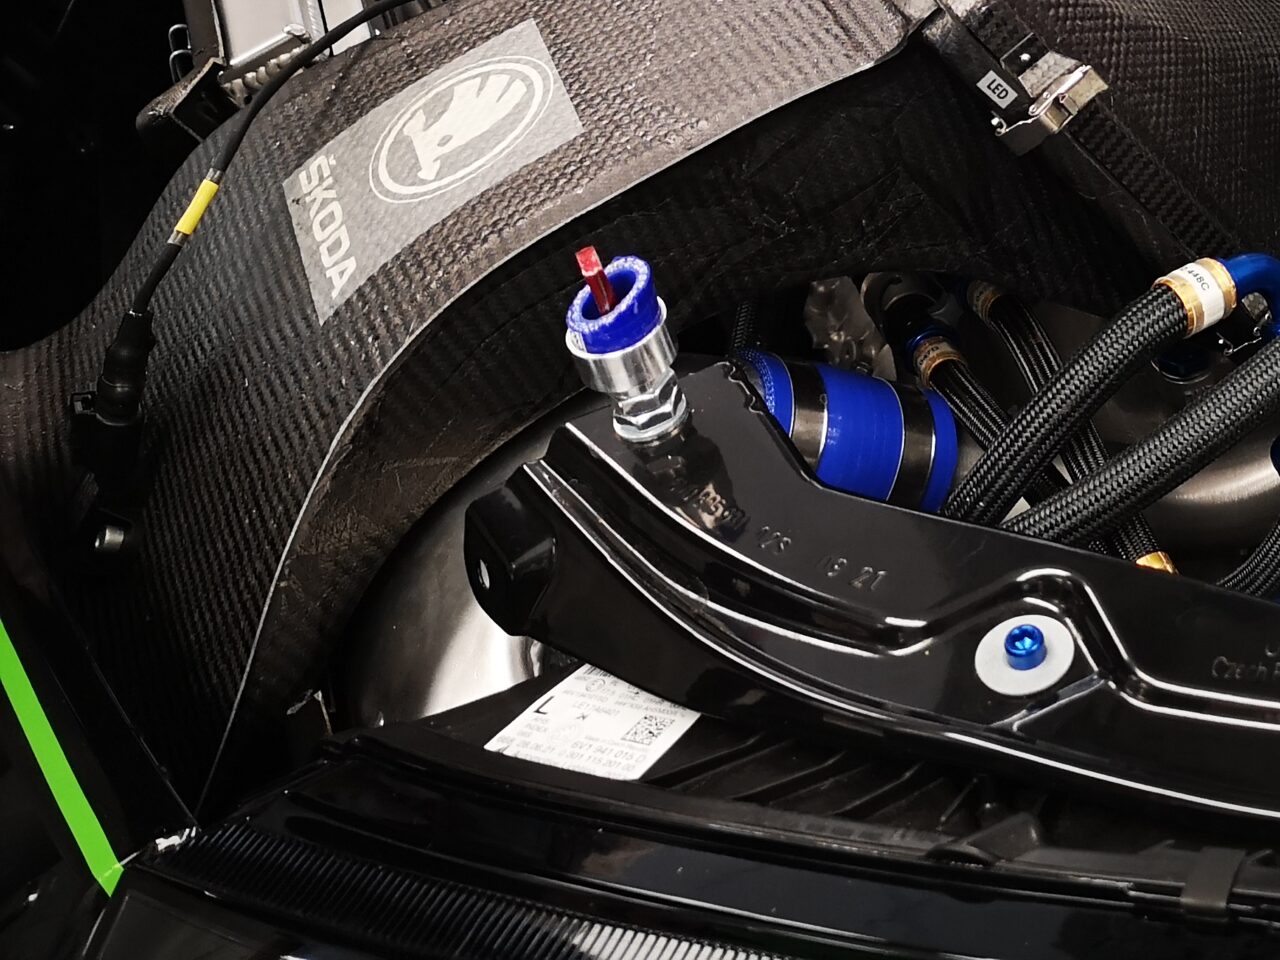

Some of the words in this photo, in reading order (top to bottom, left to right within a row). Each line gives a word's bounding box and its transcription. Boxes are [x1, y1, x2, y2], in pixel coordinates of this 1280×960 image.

[986, 78, 1009, 100] LED
[299, 153, 357, 300] ŠKODA
[534, 696, 554, 715] L
